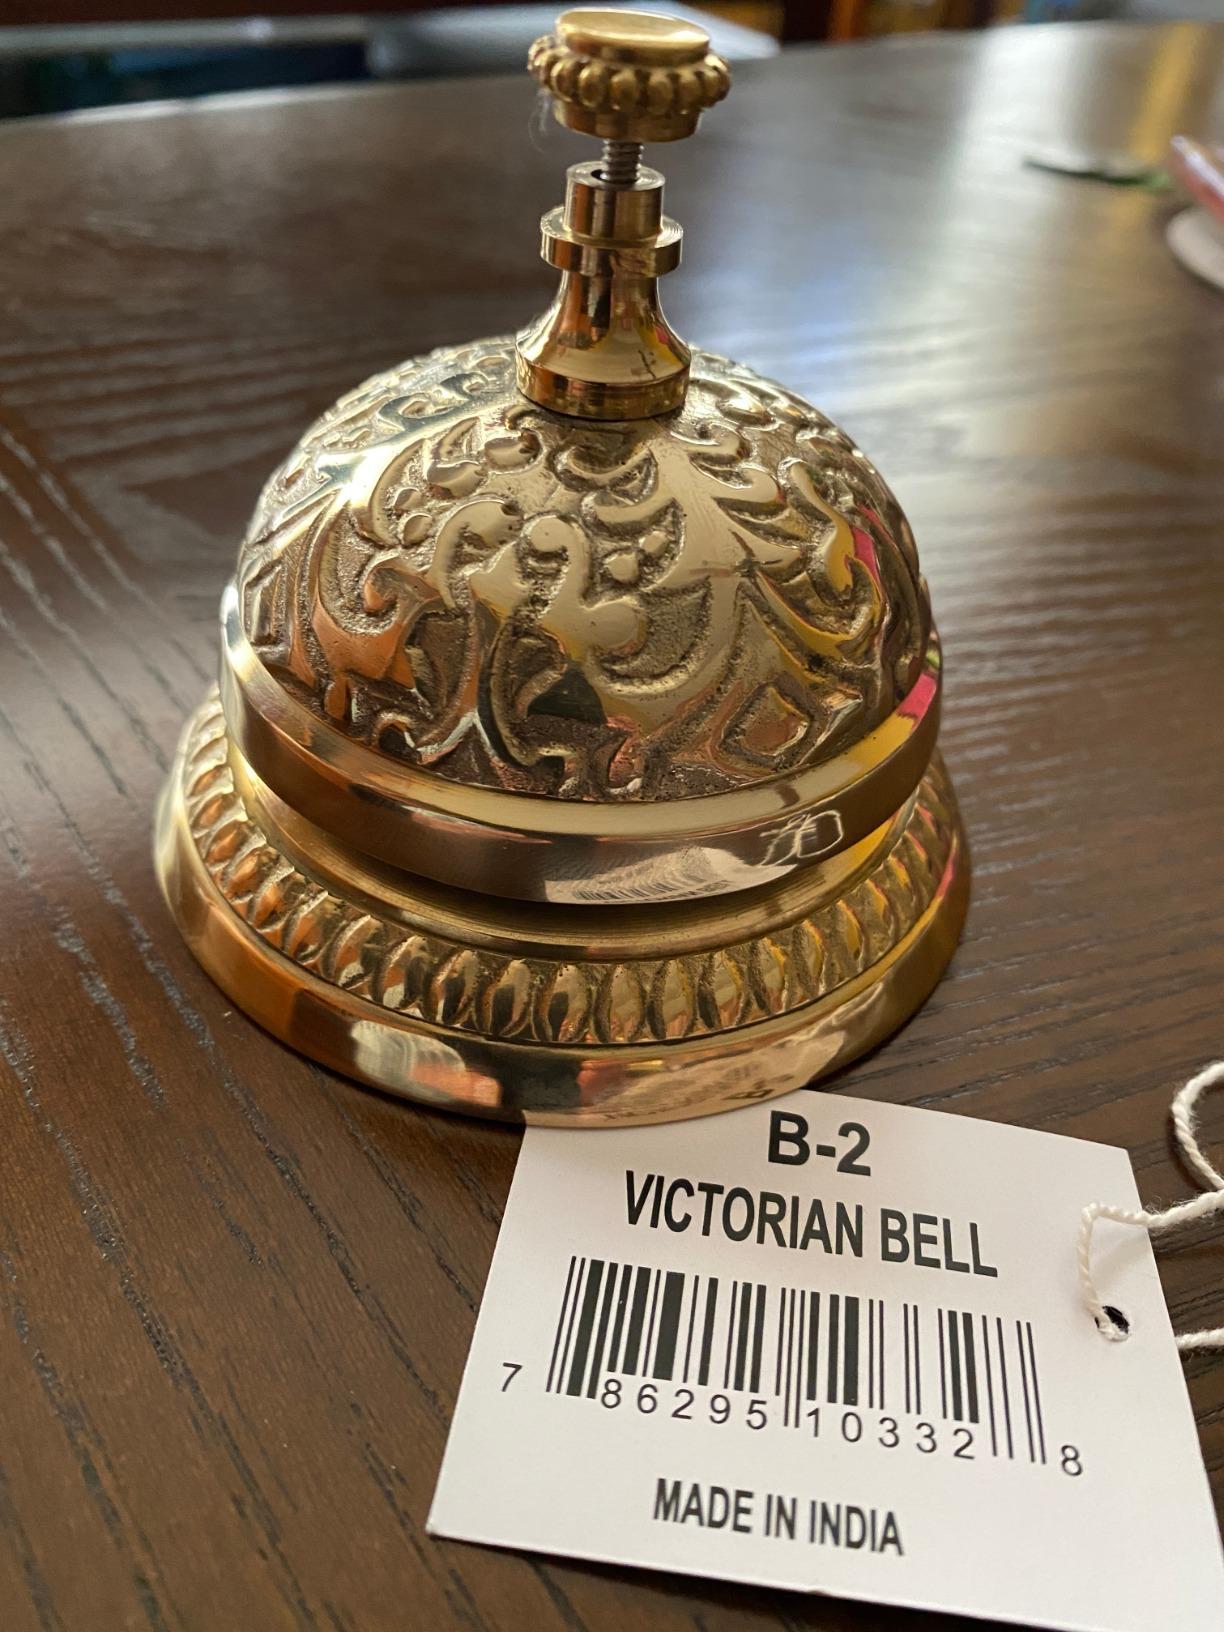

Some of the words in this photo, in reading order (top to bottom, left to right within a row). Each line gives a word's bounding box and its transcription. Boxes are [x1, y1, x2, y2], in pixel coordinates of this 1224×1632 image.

[768, 1110, 871, 1177] B-2
[625, 1169, 863, 1258] VICTORIAN
[880, 1208, 998, 1278] BELL
[501, 1362, 523, 1392] 7
[1060, 1445, 1084, 1476] 8
[653, 1478, 755, 1533] MADE
[765, 1493, 798, 1540] IN
[809, 1500, 904, 1556] INDIA
